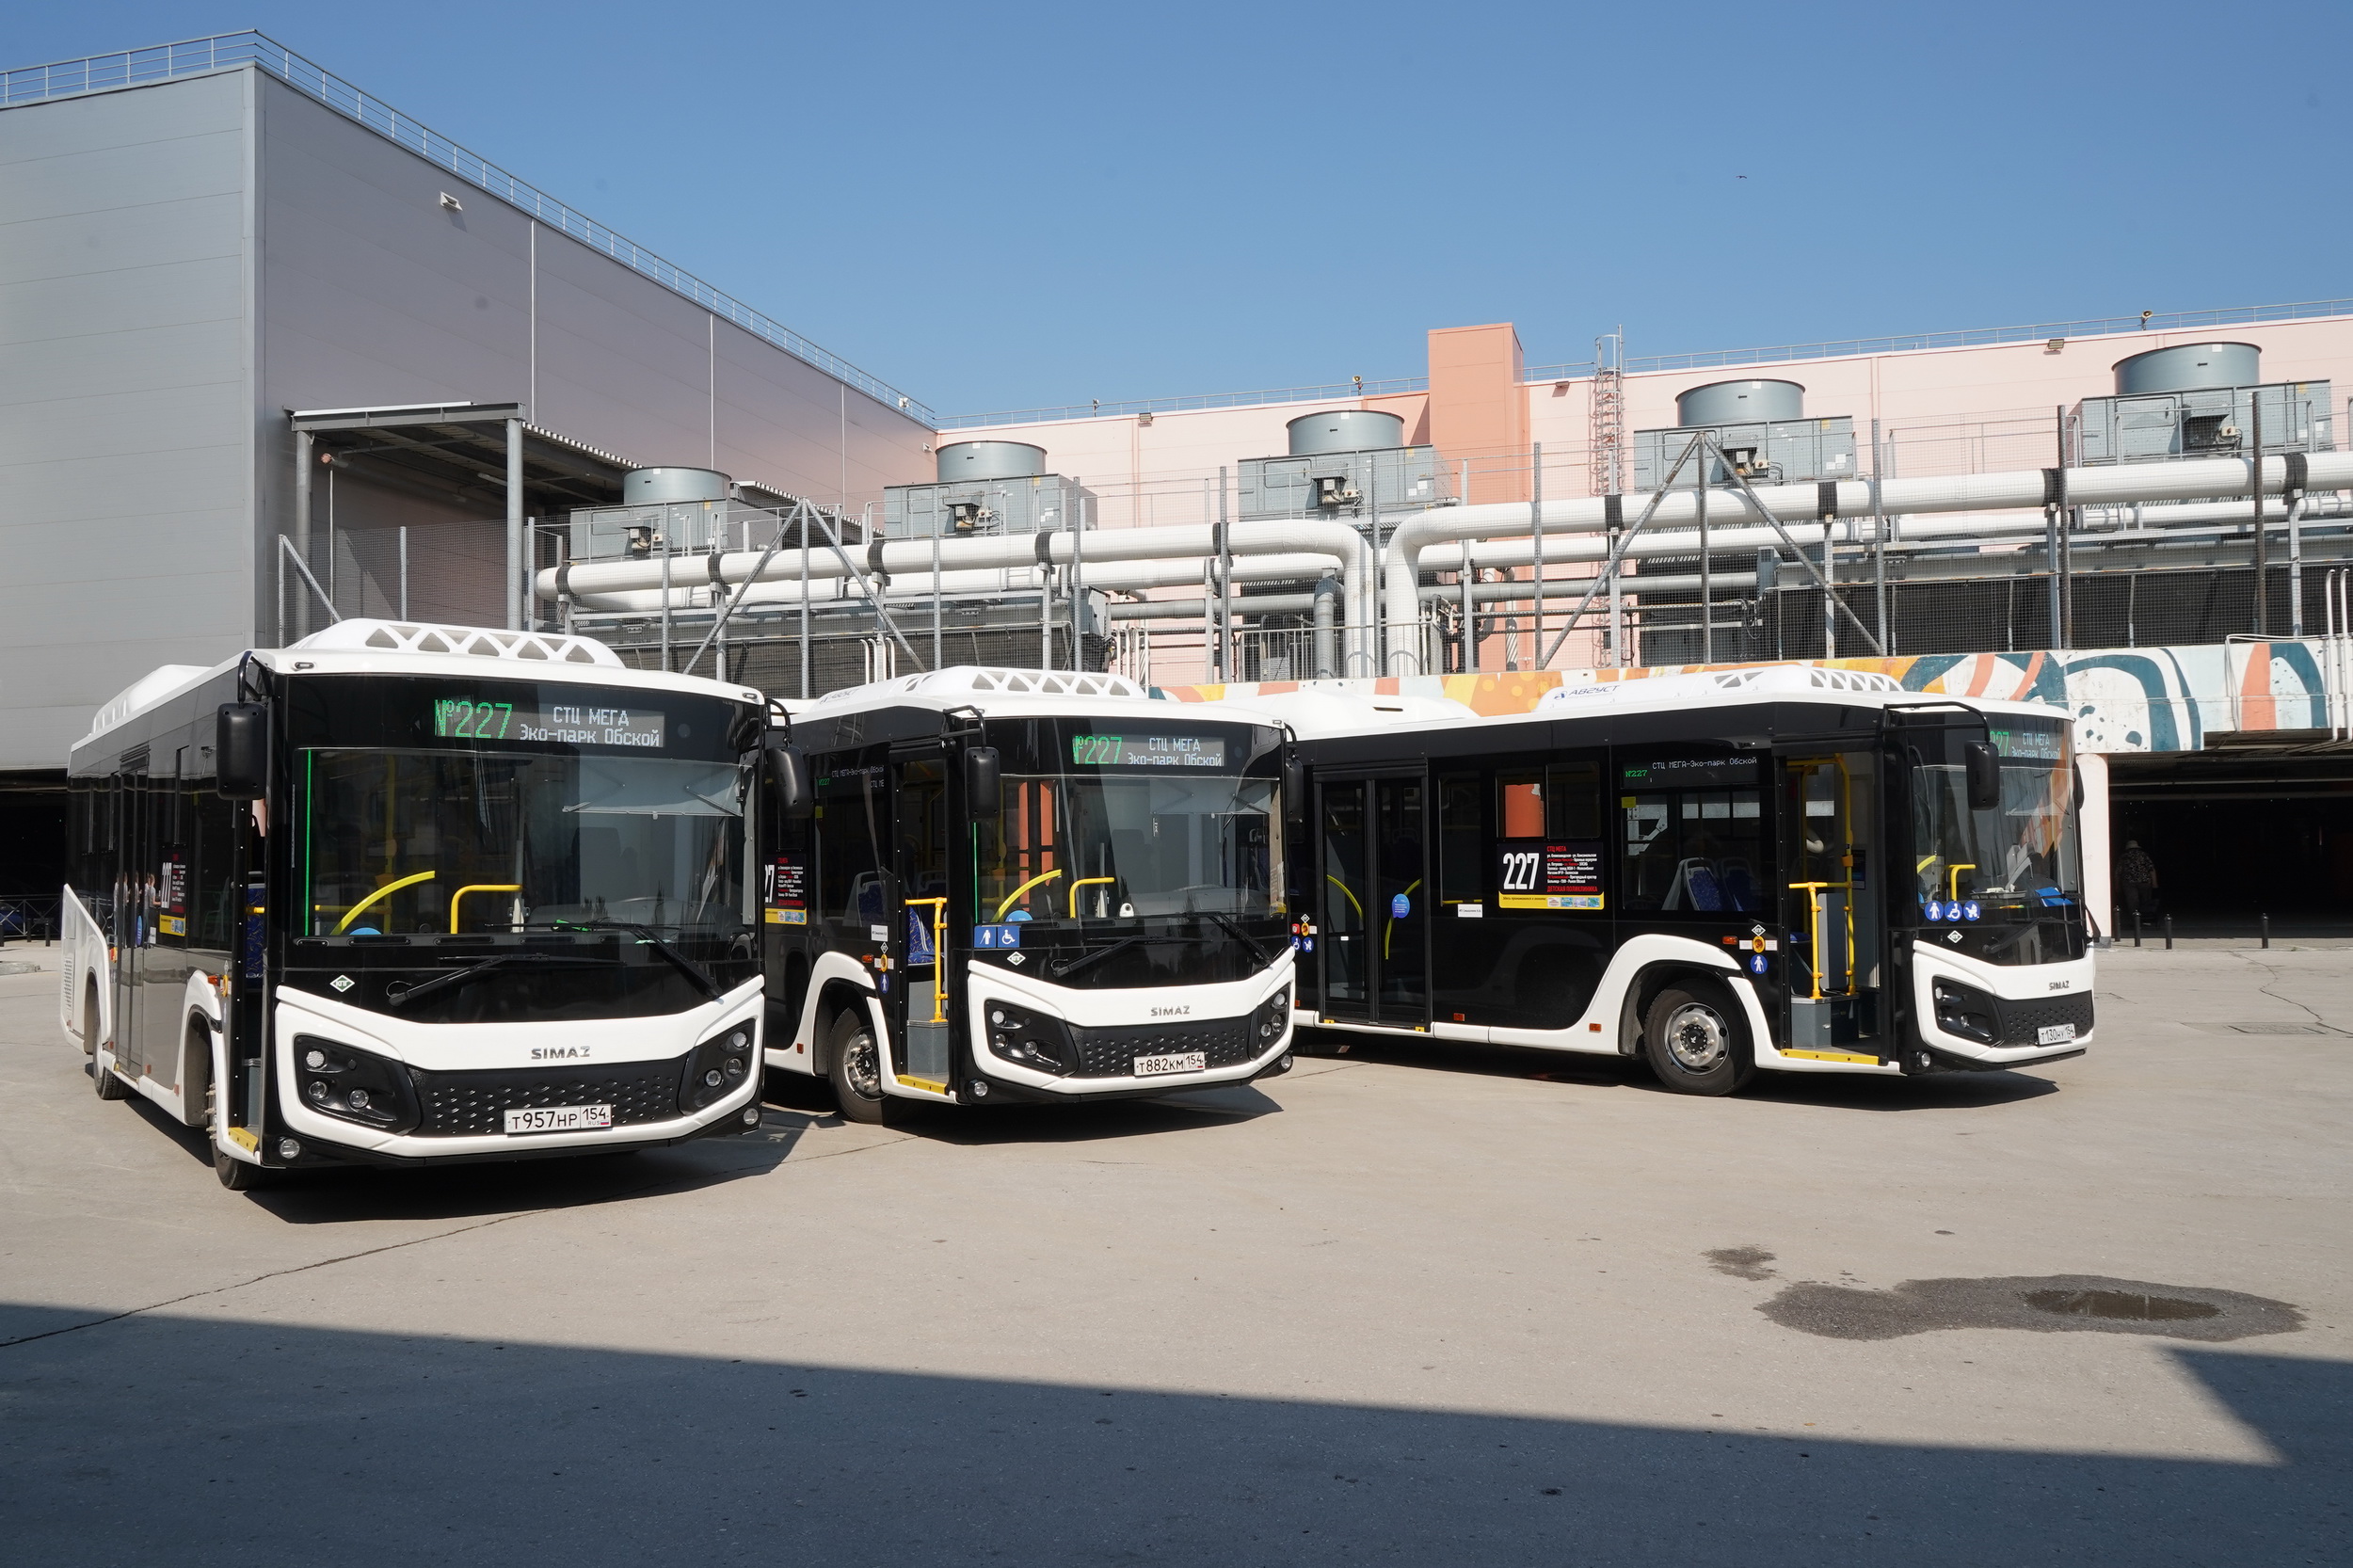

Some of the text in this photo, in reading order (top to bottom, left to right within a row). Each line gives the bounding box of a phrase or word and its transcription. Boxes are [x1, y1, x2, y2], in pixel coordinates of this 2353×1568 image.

[552, 706, 630, 727] СТЦ МЕГА
[520, 723, 660, 747] Эко-парк Обской
[1148, 737, 1201, 752] СТЦ МЕГА
[1128, 752, 1222, 767] Эко-парк Обской
[1652, 761, 1665, 770] СТЦ
[1729, 757, 1757, 765] Обской
[1503, 853, 1540, 889] 227
[1151, 1005, 1190, 1016] SIMAZ
[531, 1046, 590, 1060] SIMAZ
[1186, 1054, 1202, 1064] 154
[511, 1107, 606, 1129] Т957НР 154
